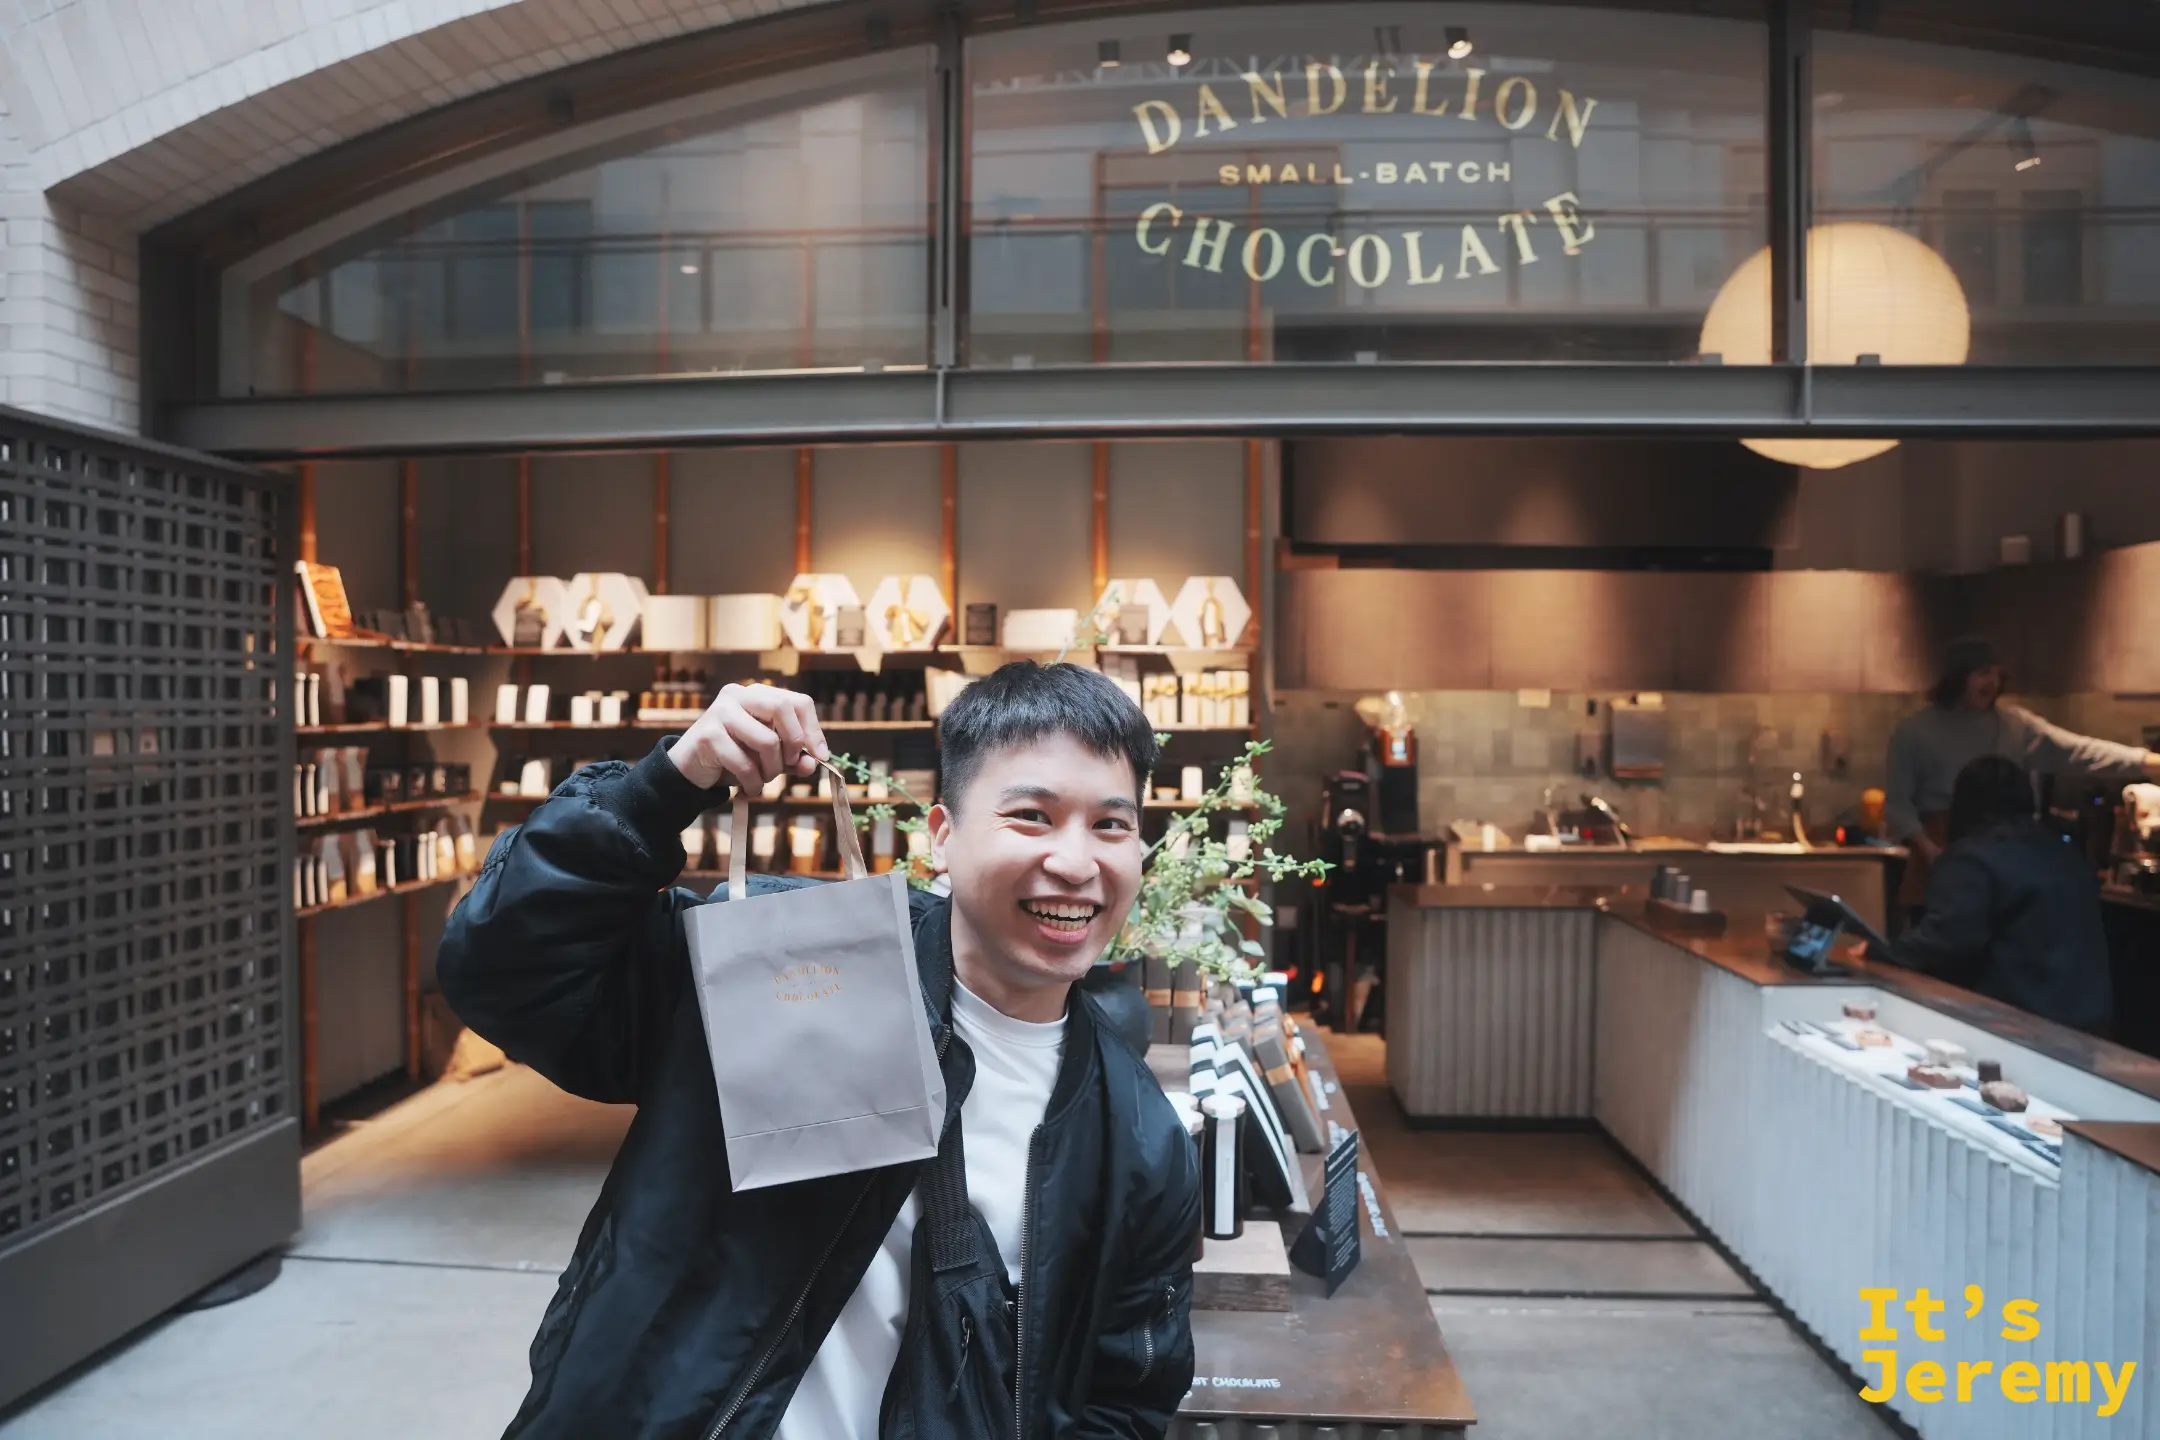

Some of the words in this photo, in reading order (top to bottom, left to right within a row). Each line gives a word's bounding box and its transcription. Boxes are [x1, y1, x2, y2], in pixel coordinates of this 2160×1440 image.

[1132, 61, 1597, 154] DANDELION
[1219, 161, 1511, 185] SMALL-BATCH
[1136, 192, 1596, 288] CHOCOLATE
